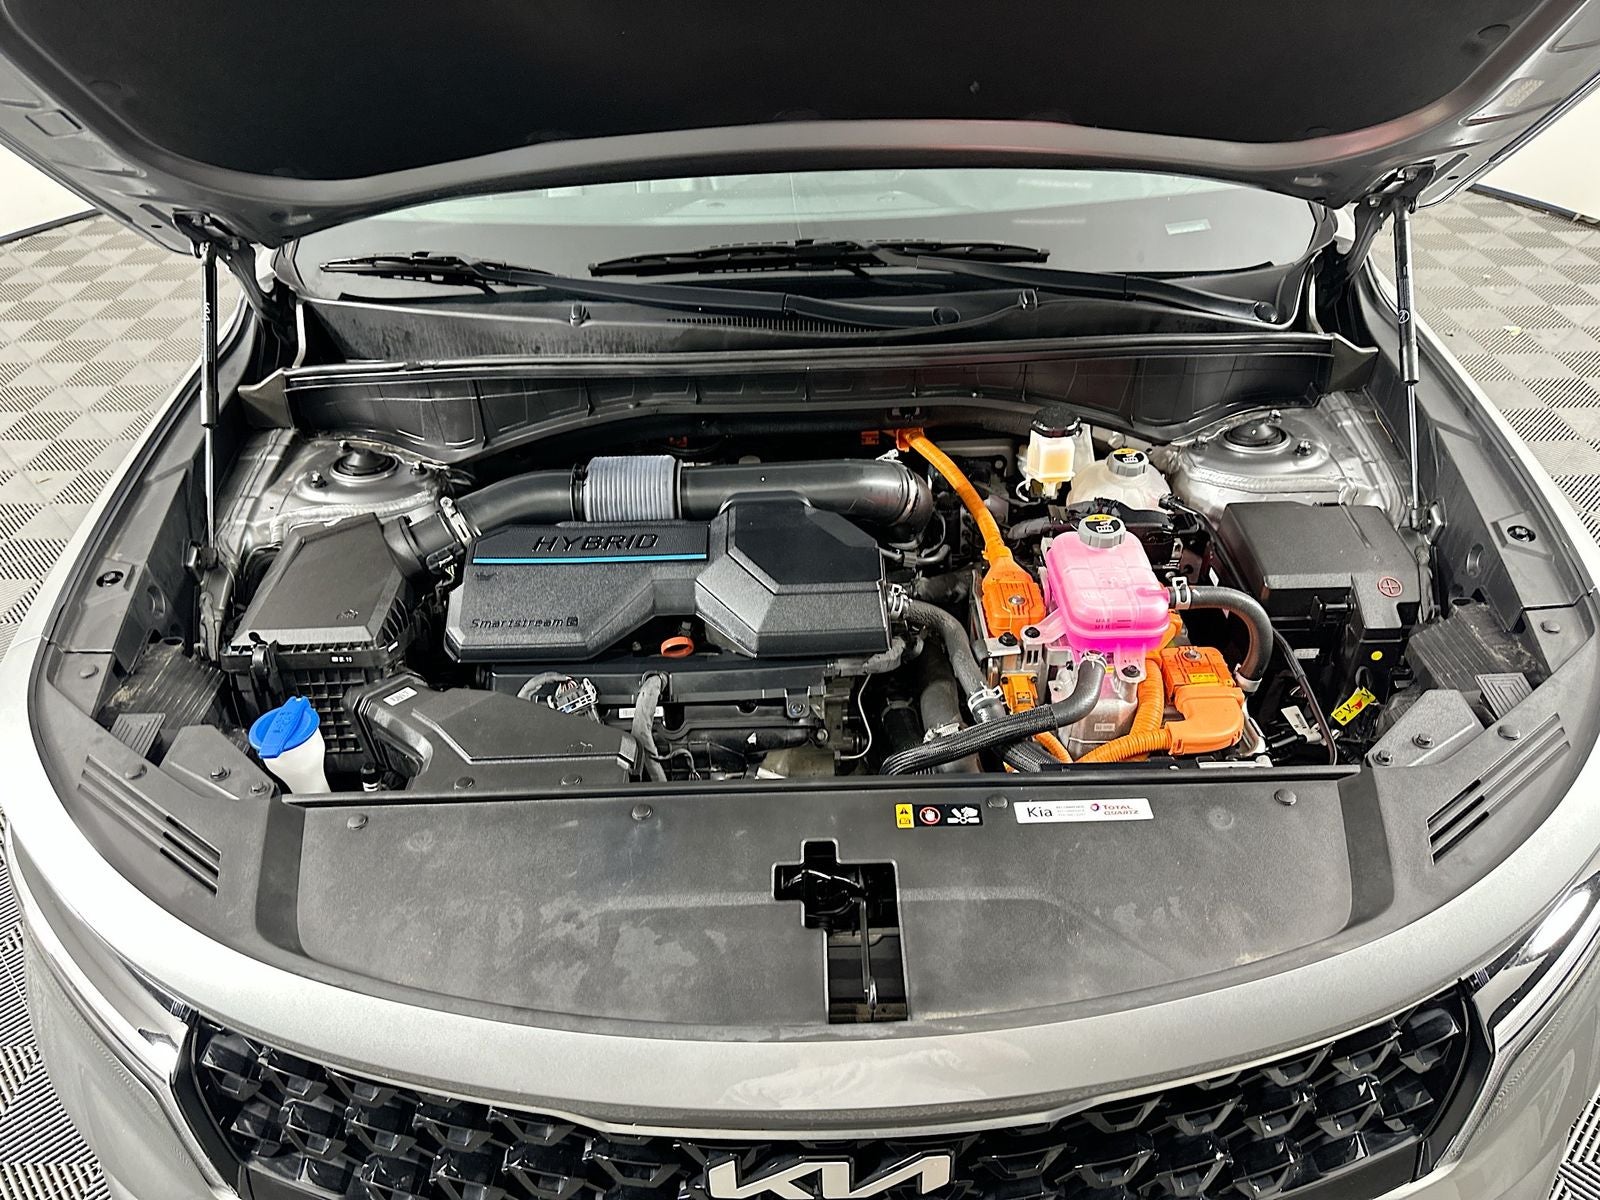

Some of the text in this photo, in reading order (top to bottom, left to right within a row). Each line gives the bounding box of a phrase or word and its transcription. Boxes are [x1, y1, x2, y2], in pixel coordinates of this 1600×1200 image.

[531, 534, 659, 552] HYBRID
[471, 618, 564, 628] Smartstream
[1027, 806, 1053, 818] Kia
[708, 1155, 951, 1200] KIA
